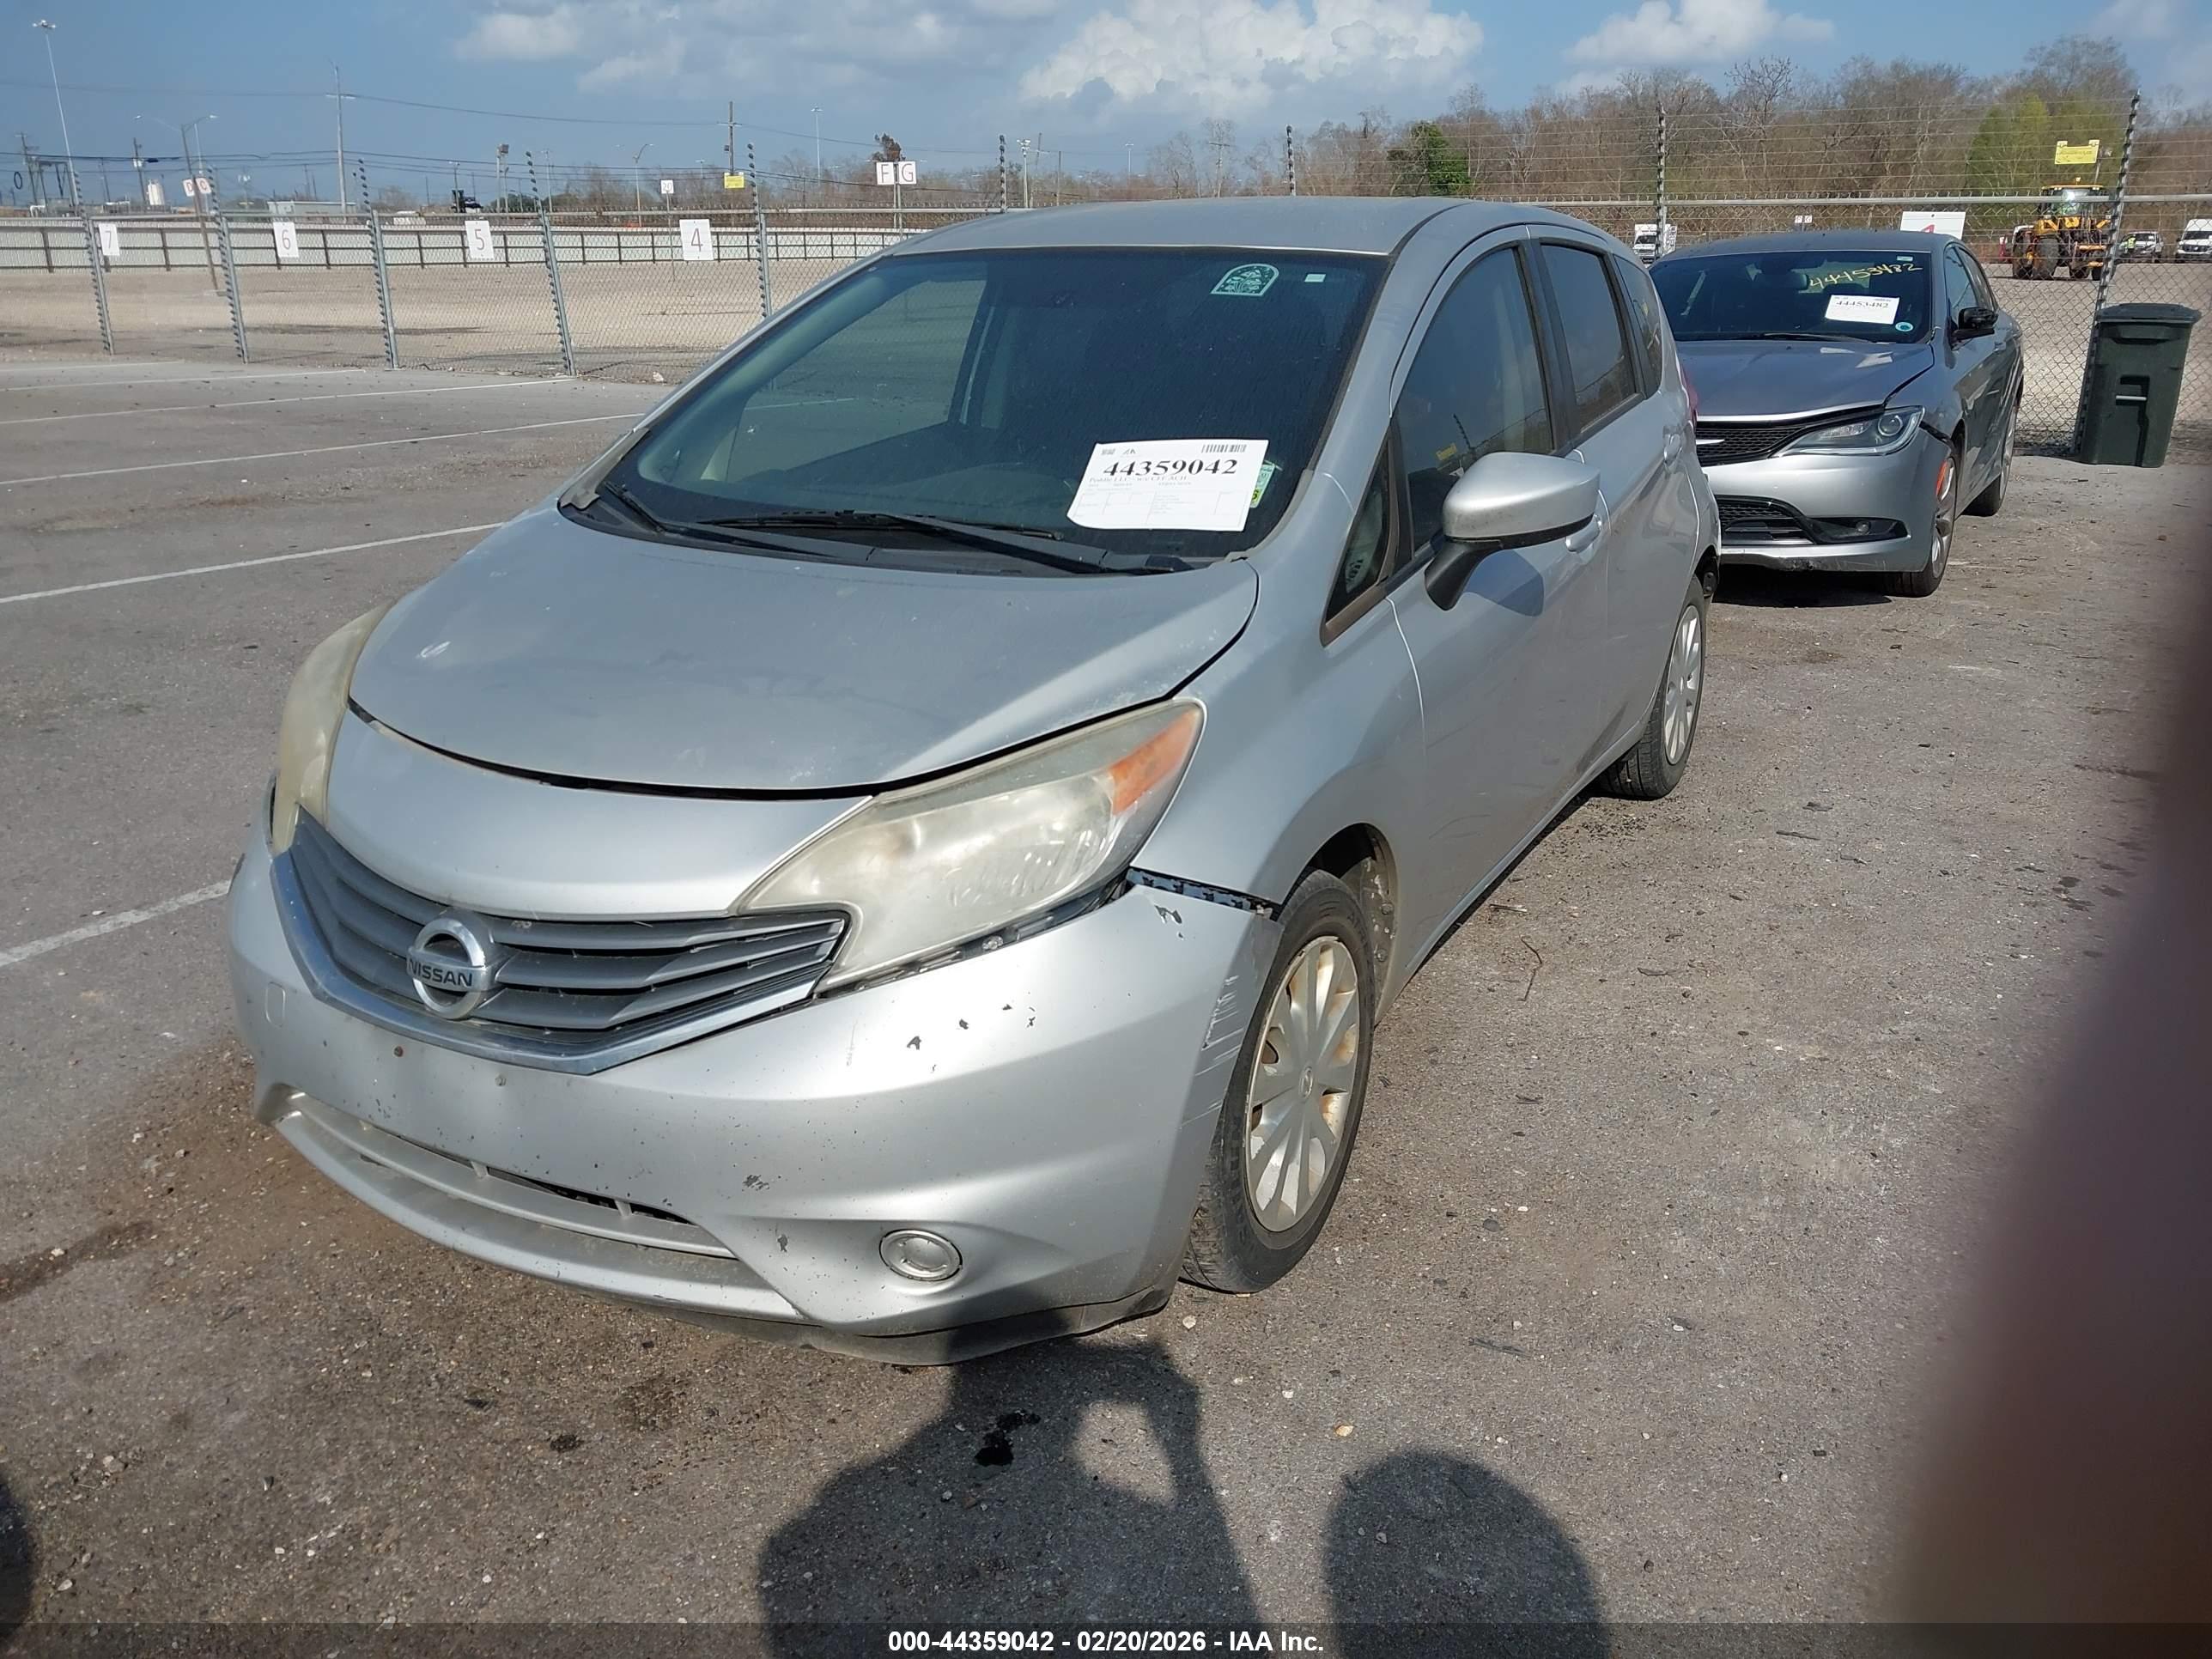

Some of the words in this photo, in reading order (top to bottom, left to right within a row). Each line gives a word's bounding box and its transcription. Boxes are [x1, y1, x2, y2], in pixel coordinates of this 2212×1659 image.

[881, 163, 890, 183] F
[902, 163, 914, 183] G
[105, 230, 112, 249] 7
[281, 228, 291, 250] 6
[474, 228, 485, 250] 5
[690, 228, 703, 252] 4
[1809, 263, 1923, 289] 44453482
[1103, 459, 1237, 476] 44359042
[410, 957, 472, 987] NISSAN
